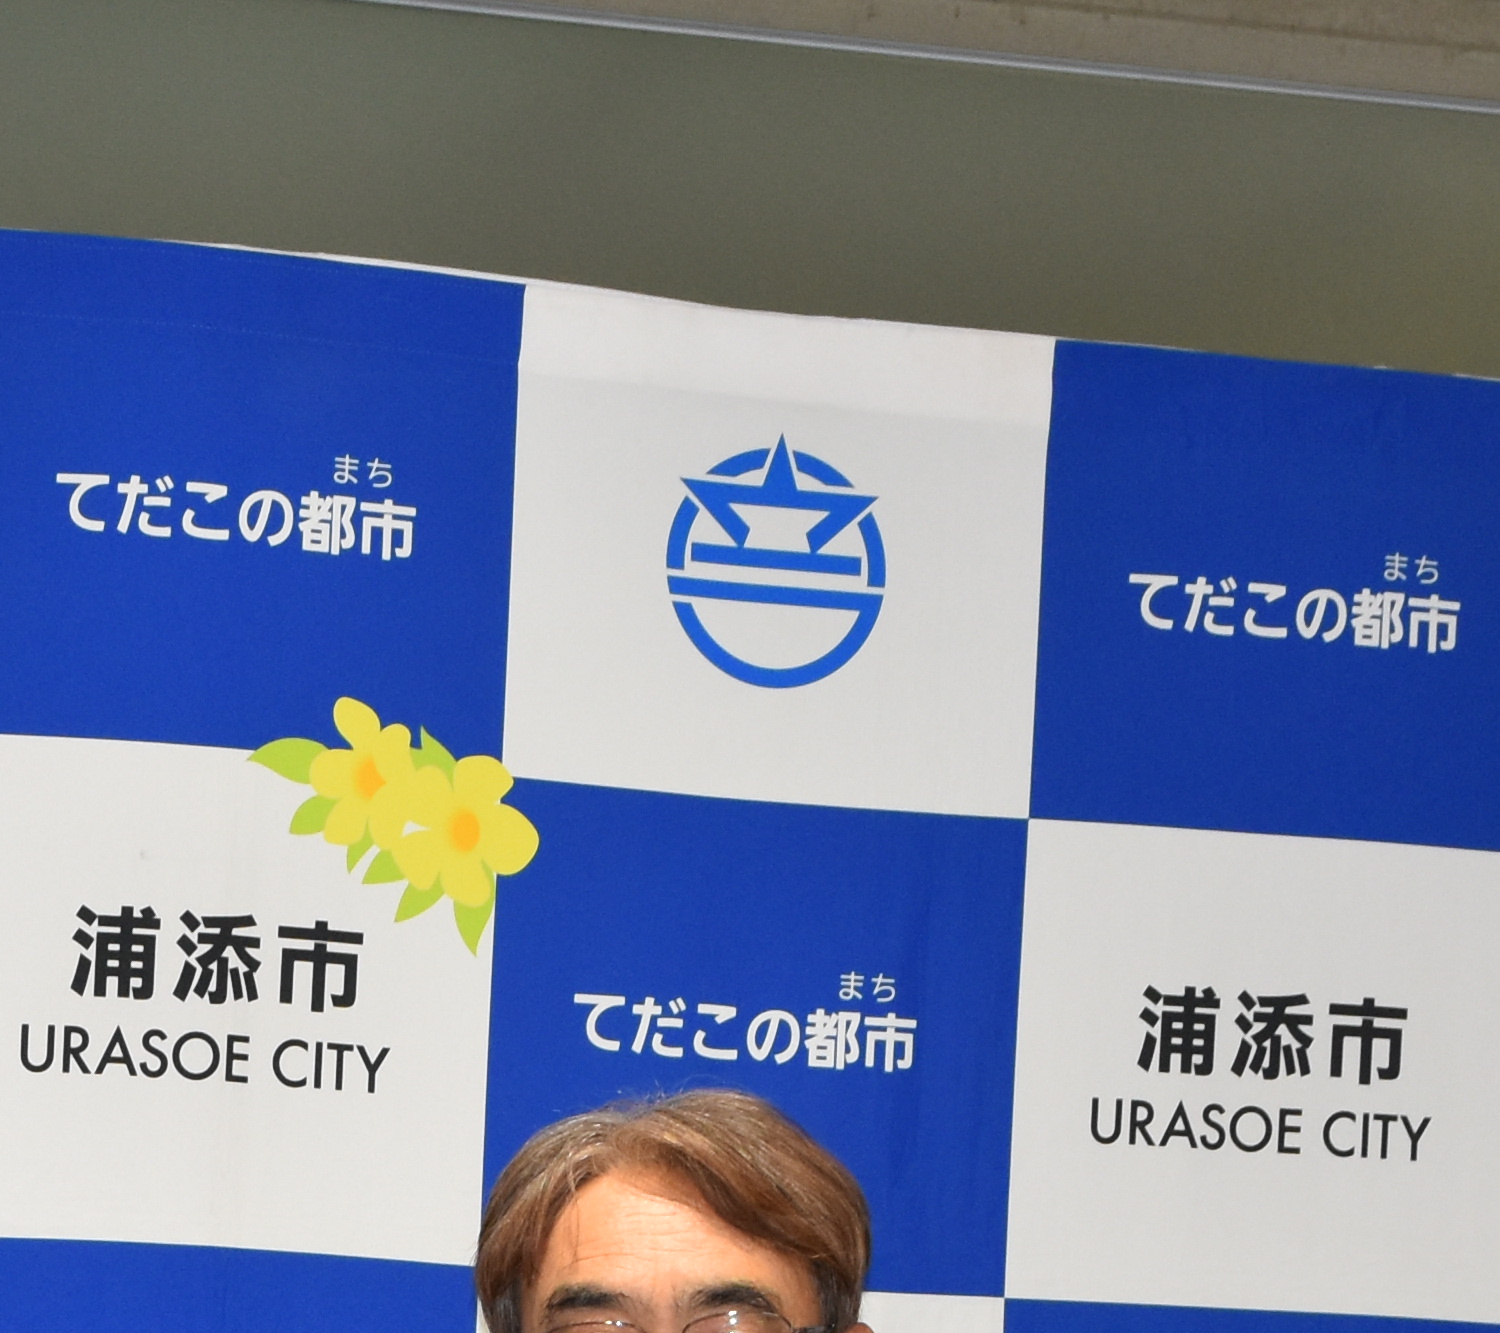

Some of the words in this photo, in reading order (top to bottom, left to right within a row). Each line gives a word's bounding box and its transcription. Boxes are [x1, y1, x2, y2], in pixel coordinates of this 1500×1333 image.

[334, 454, 392, 487] まち
[56, 473, 416, 560] てだこの都市
[1385, 553, 1438, 583] まち
[1129, 574, 1460, 653] てだこの都市
[71, 906, 363, 1012] 浦添市
[839, 972, 895, 1002] まち
[21, 1024, 249, 1083] URASOE
[273, 1040, 389, 1093] CITY
[574, 994, 917, 1072] てだこの都市
[1138, 986, 1407, 1085] 浦添市
[1091, 1098, 1302, 1154] URASOE
[1323, 1111, 1430, 1161] CITY
